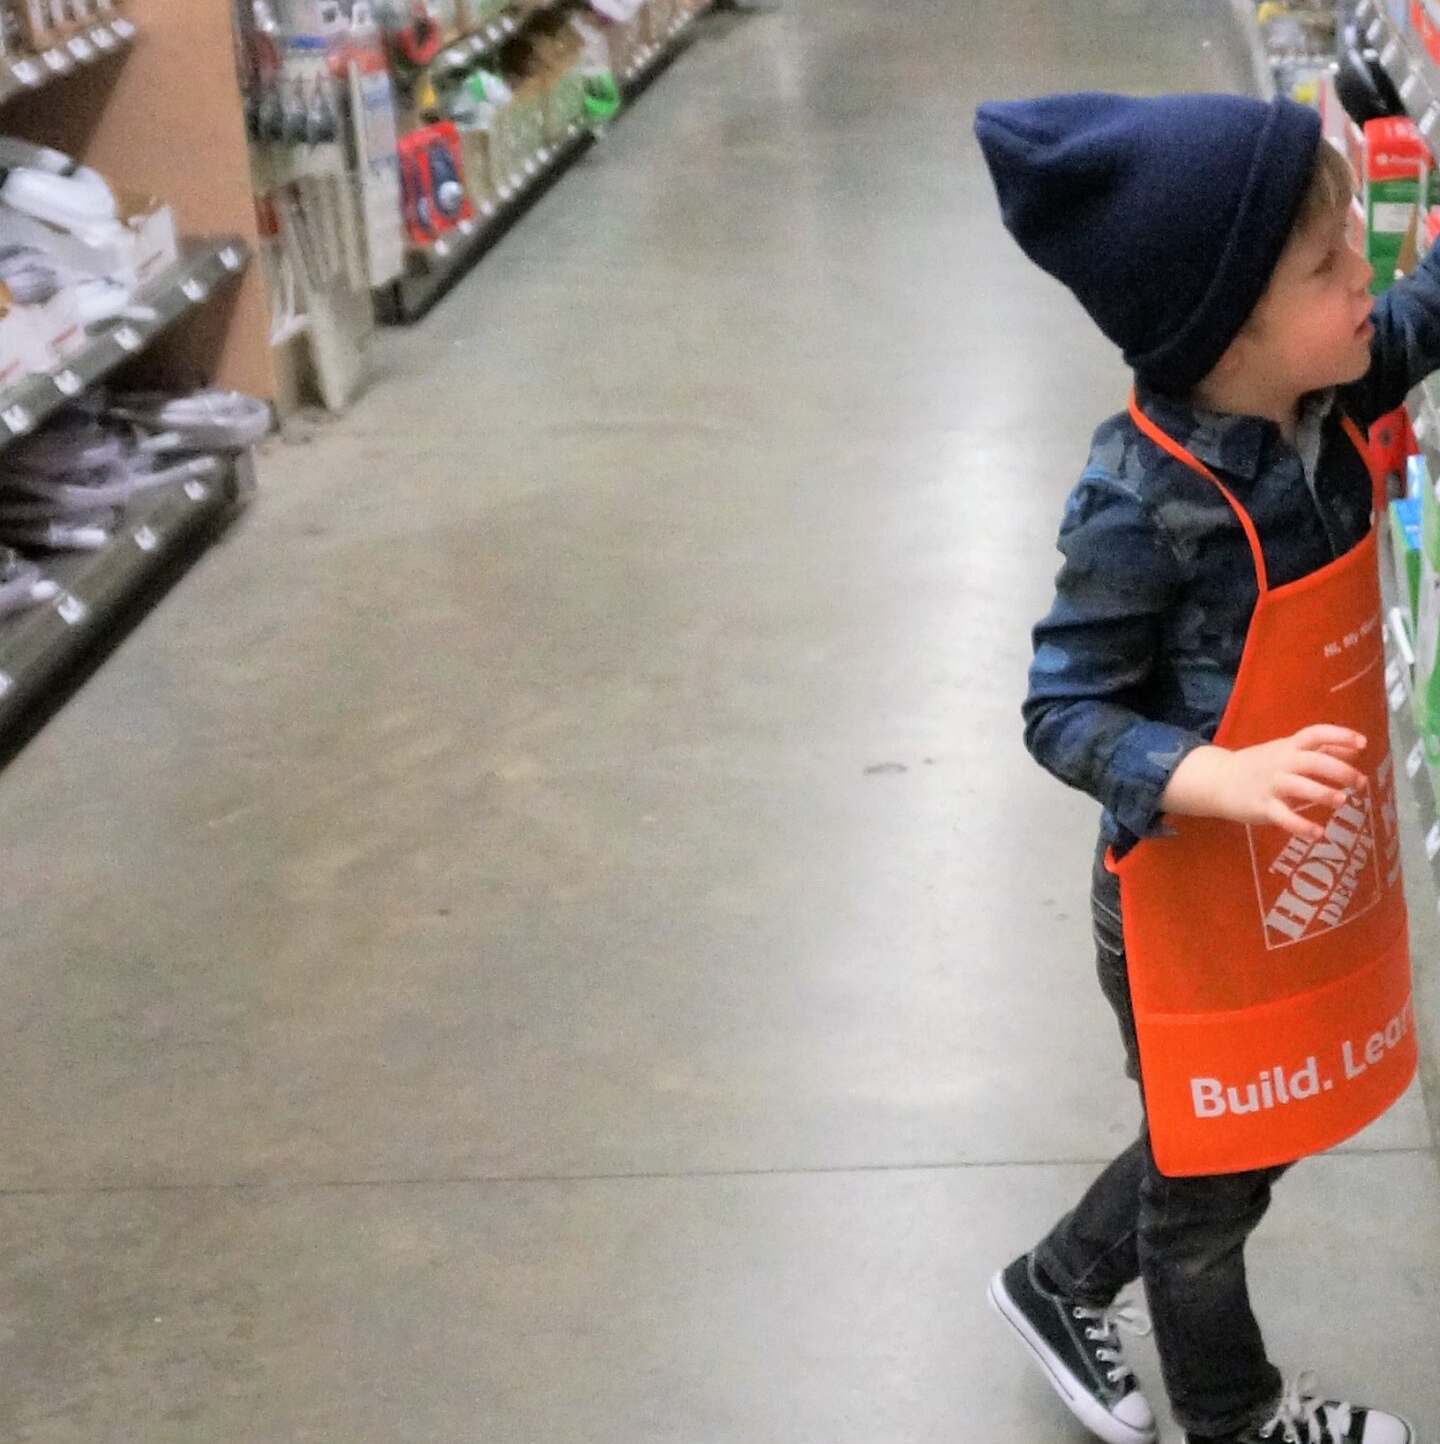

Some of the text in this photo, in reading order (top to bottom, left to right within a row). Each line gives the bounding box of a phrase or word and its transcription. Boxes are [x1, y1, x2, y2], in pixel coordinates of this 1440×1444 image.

[1265, 786, 1369, 942] HOME
[1318, 830, 1374, 929] DEPOT
[1190, 1055, 1334, 1119] Build.
